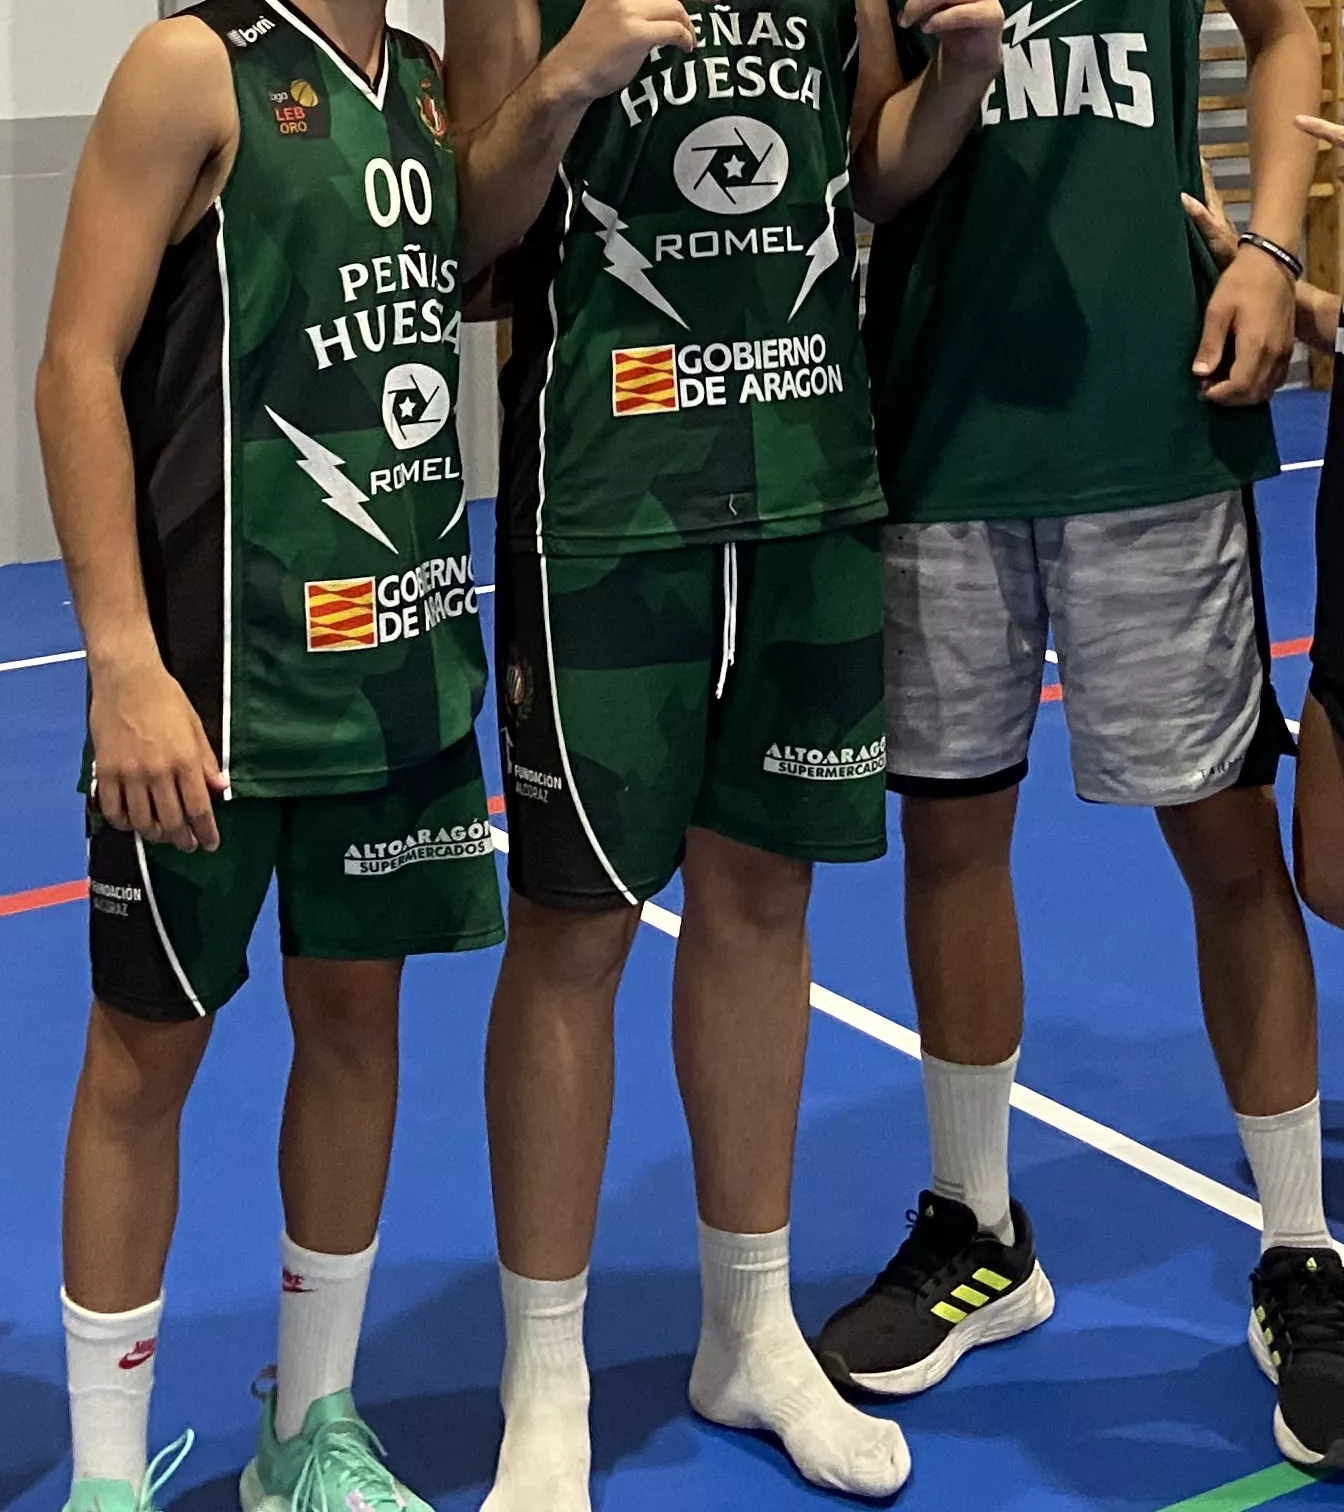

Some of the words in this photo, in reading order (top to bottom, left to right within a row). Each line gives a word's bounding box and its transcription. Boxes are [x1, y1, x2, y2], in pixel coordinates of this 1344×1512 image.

[620, 55, 823, 128] HUESCA
[275, 106, 306, 121] LEB
[280, 121, 308, 134] ORO
[364, 158, 432, 228] 00
[656, 225, 804, 262] ROMEL
[678, 334, 826, 374] GOBIERNO
[679, 376, 727, 408] DE
[739, 364, 843, 404] ARAGON
[379, 605, 419, 643] DE
[360, 841, 486, 873] SUPERMERCADOS
